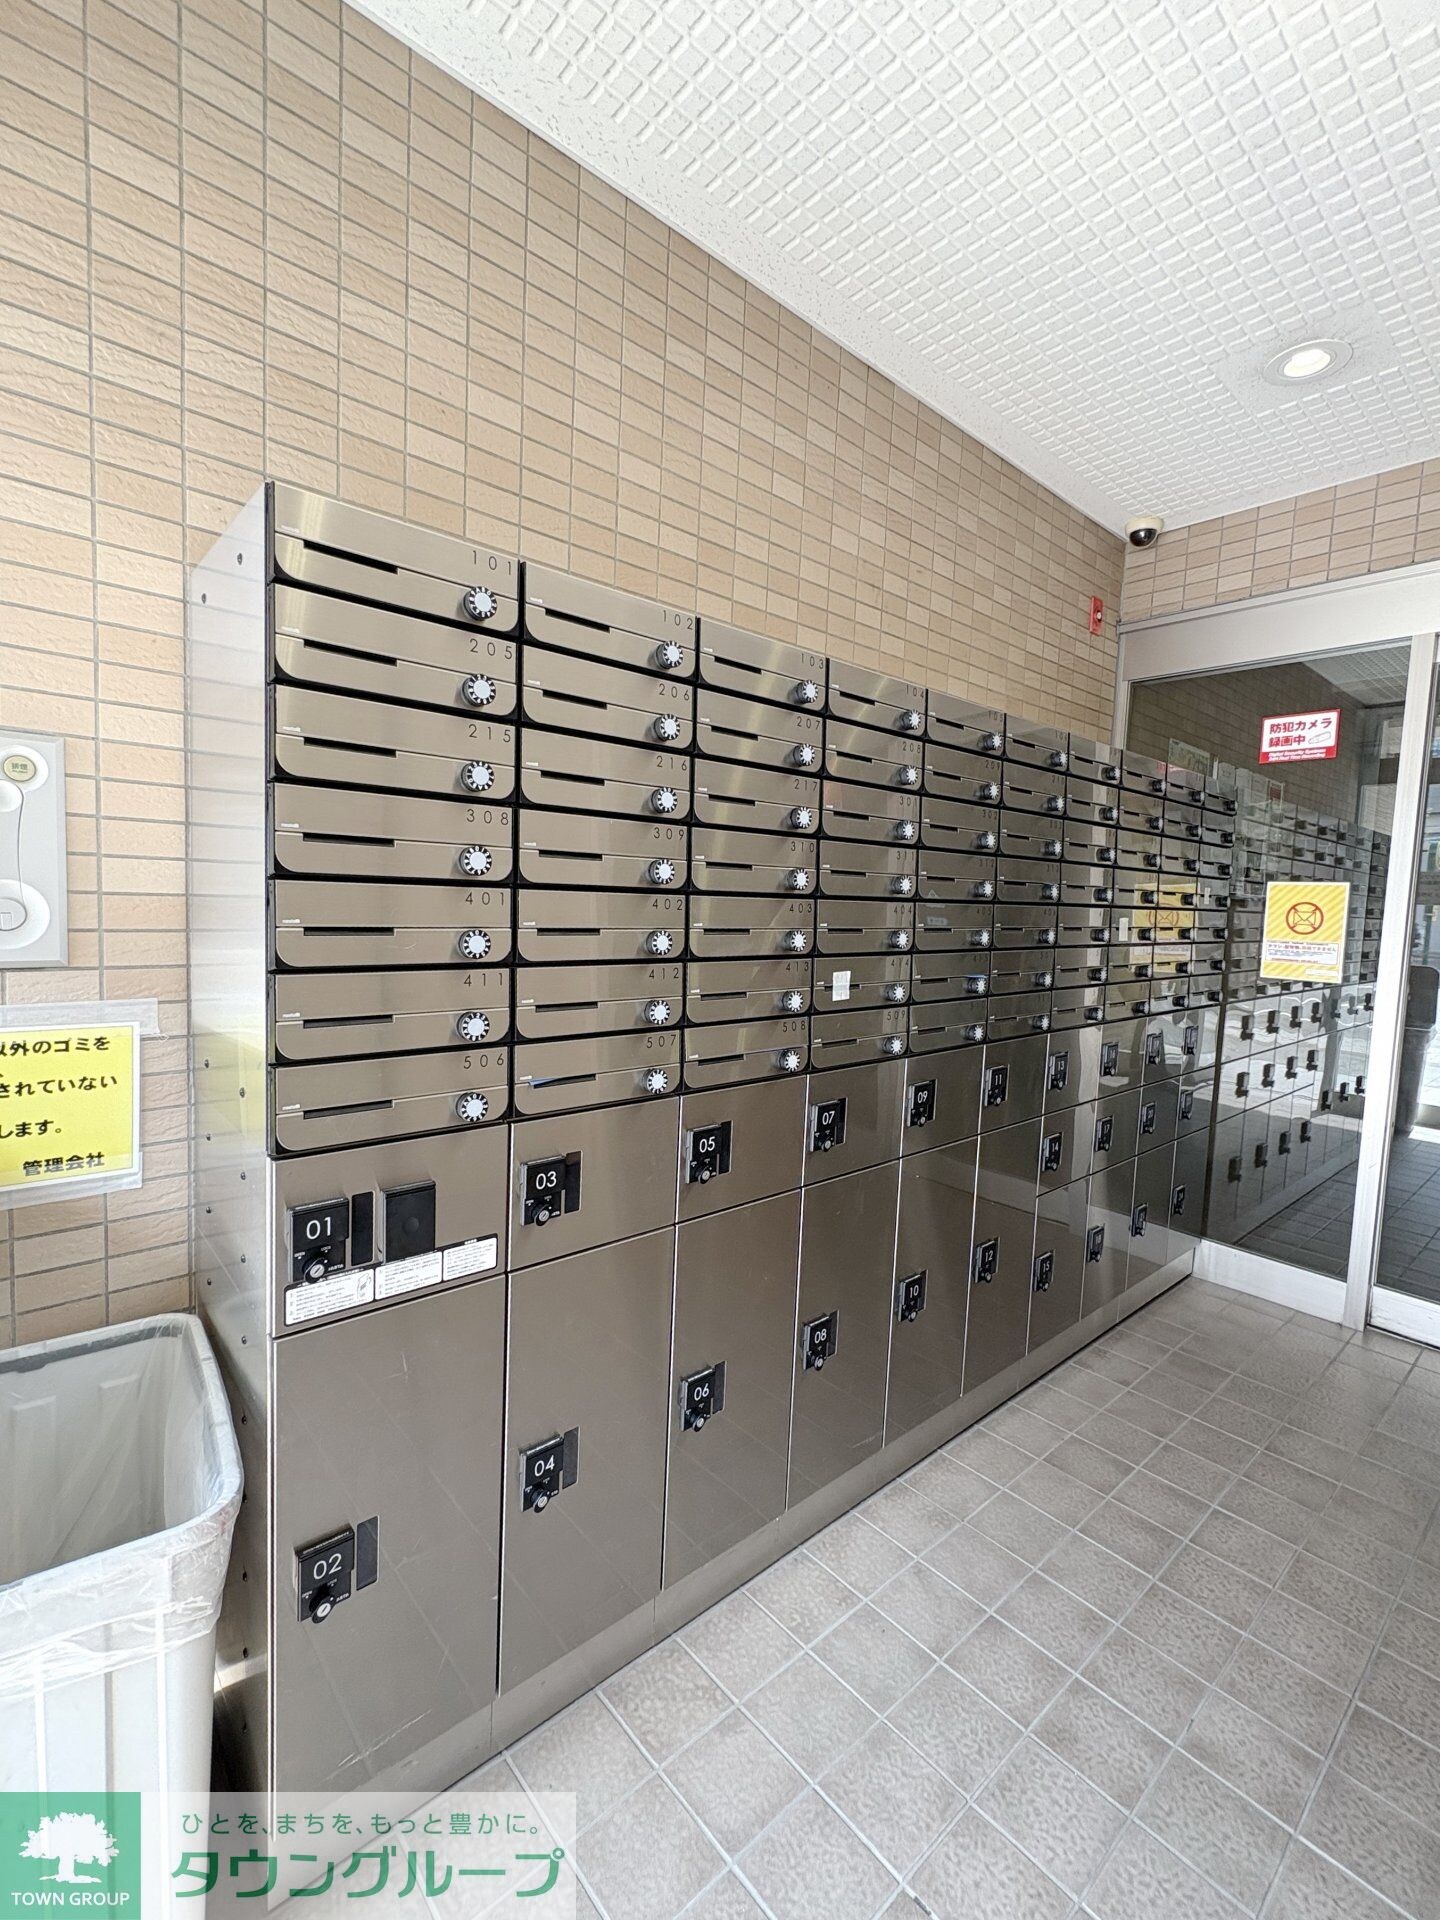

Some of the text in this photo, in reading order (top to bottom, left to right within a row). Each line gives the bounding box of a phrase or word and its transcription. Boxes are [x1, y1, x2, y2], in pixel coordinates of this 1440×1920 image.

[472, 549, 514, 576] 101
[663, 610, 694, 630] 102
[469, 637, 513, 661] 205
[800, 652, 824, 670] 103
[658, 683, 691, 701] 206
[905, 684, 924, 699] 104
[796, 716, 820, 731] 207
[1269, 717, 1333, 735] 防犯カメラ
[468, 723, 511, 744] 215
[902, 740, 921, 754] 208
[656, 755, 688, 772] 216
[794, 777, 818, 791] 217
[466, 808, 510, 827] 308
[653, 825, 685, 841] 309
[791, 840, 815, 853] 310
[465, 890, 507, 907] 401
[652, 897, 684, 912] 402
[789, 903, 813, 914] 403
[648, 966, 681, 982] 412
[786, 961, 810, 973] 413
[463, 972, 506, 989] 411
[782, 1020, 806, 1033] 508
[646, 1033, 677, 1049] 507
[463, 1053, 506, 1070] 506
[1057, 1060, 1065, 1071] 13
[995, 1073, 1002, 1086] 11
[917, 1090, 928, 1104] 09
[822, 1110, 836, 1126] 07
[699, 1136, 716, 1153] 05
[1052, 1141, 1059, 1152] 14
[23, 1151, 106, 1177] 管理会社
[535, 1170, 557, 1190] 03
[306, 1216, 331, 1240] 01
[985, 1249, 994, 1262] 12
[1043, 1260, 1050, 1273] 15
[909, 1284, 919, 1299] 10
[814, 1328, 827, 1344] 08
[694, 1382, 710, 1401] 06
[534, 1454, 555, 1477] 04
[313, 1553, 342, 1580] 02
